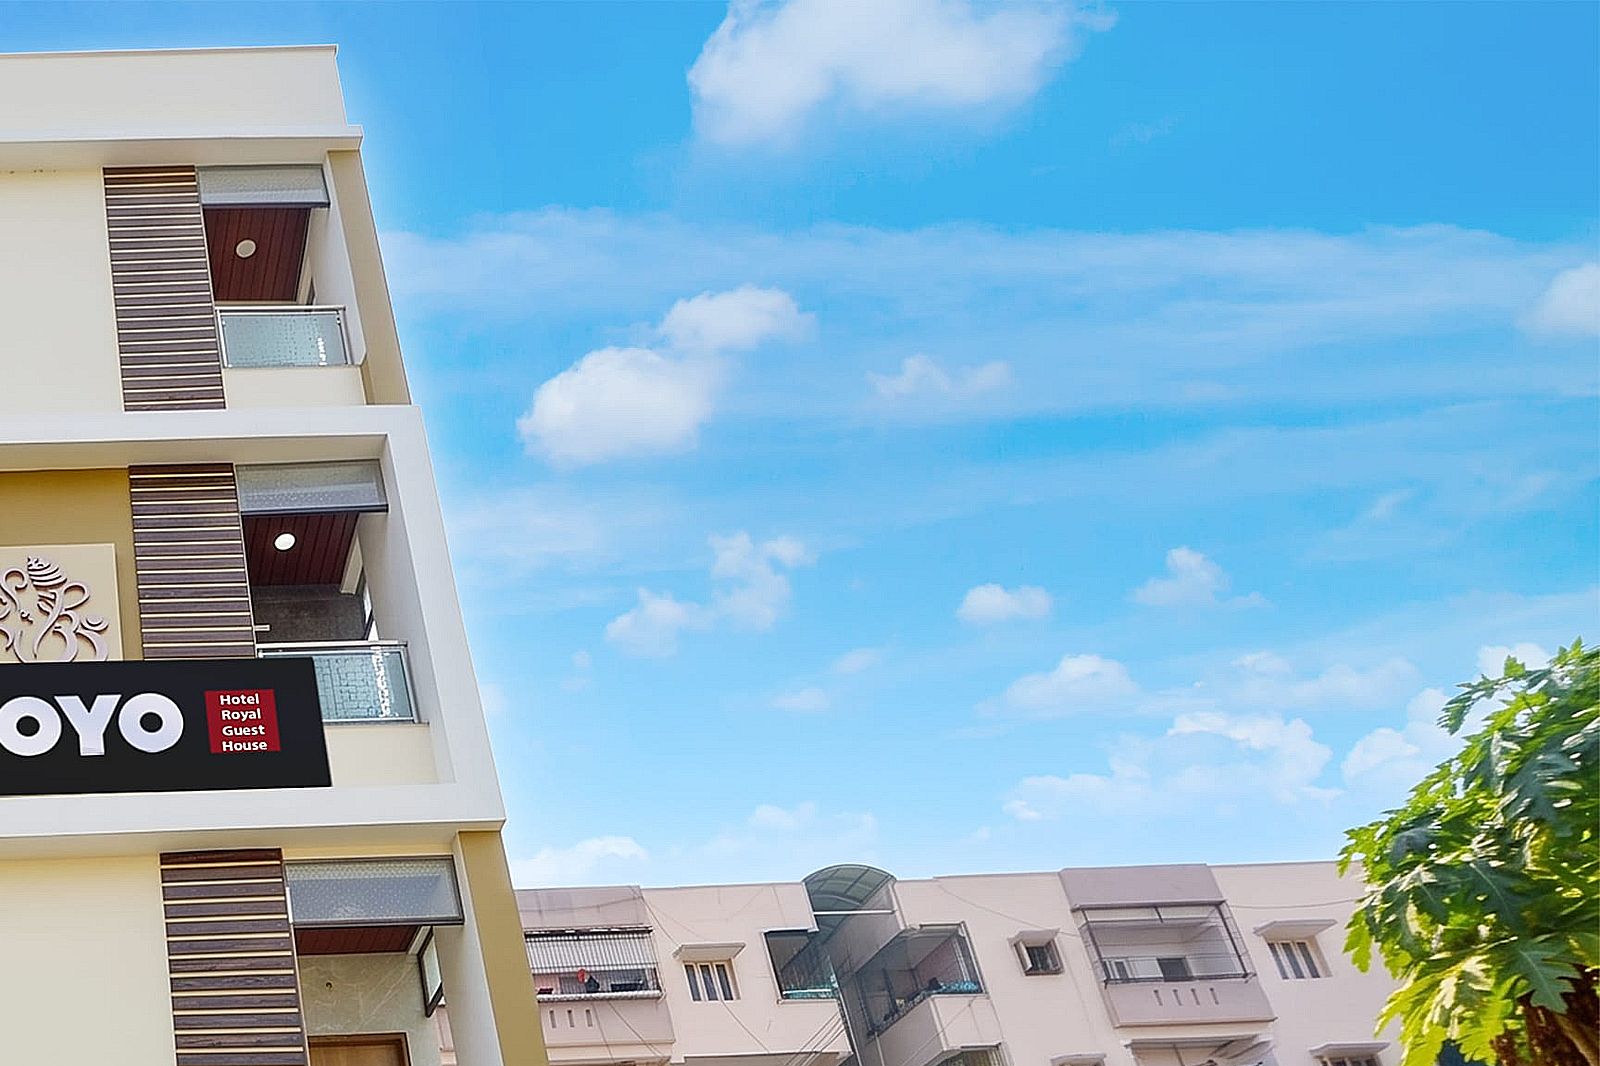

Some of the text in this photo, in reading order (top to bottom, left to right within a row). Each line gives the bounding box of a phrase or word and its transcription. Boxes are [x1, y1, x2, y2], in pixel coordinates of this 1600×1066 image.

[220, 693, 260, 706] Hotel
[221, 708, 262, 721] Royal
[222, 724, 265, 736] Guest
[222, 739, 268, 752] House
